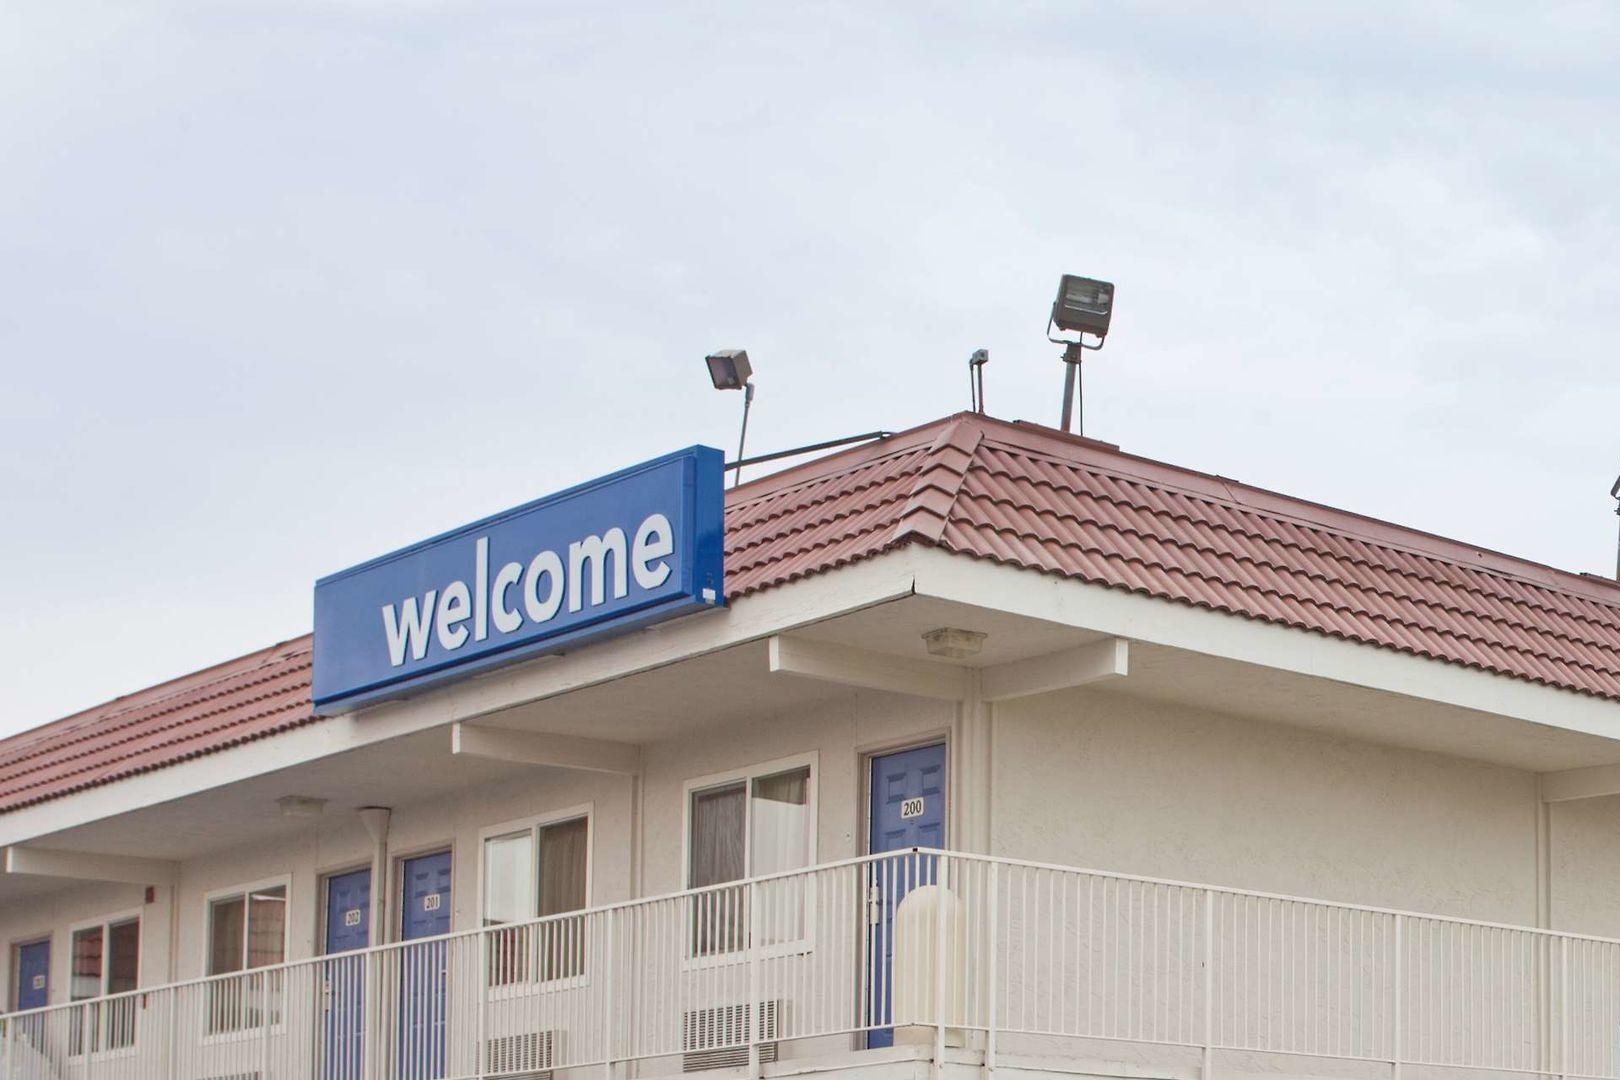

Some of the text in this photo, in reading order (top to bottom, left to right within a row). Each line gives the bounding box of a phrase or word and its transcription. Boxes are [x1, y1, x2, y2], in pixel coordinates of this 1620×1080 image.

[381, 513, 675, 667] welcome
[903, 800, 922, 816] 200
[426, 896, 439, 909] 201
